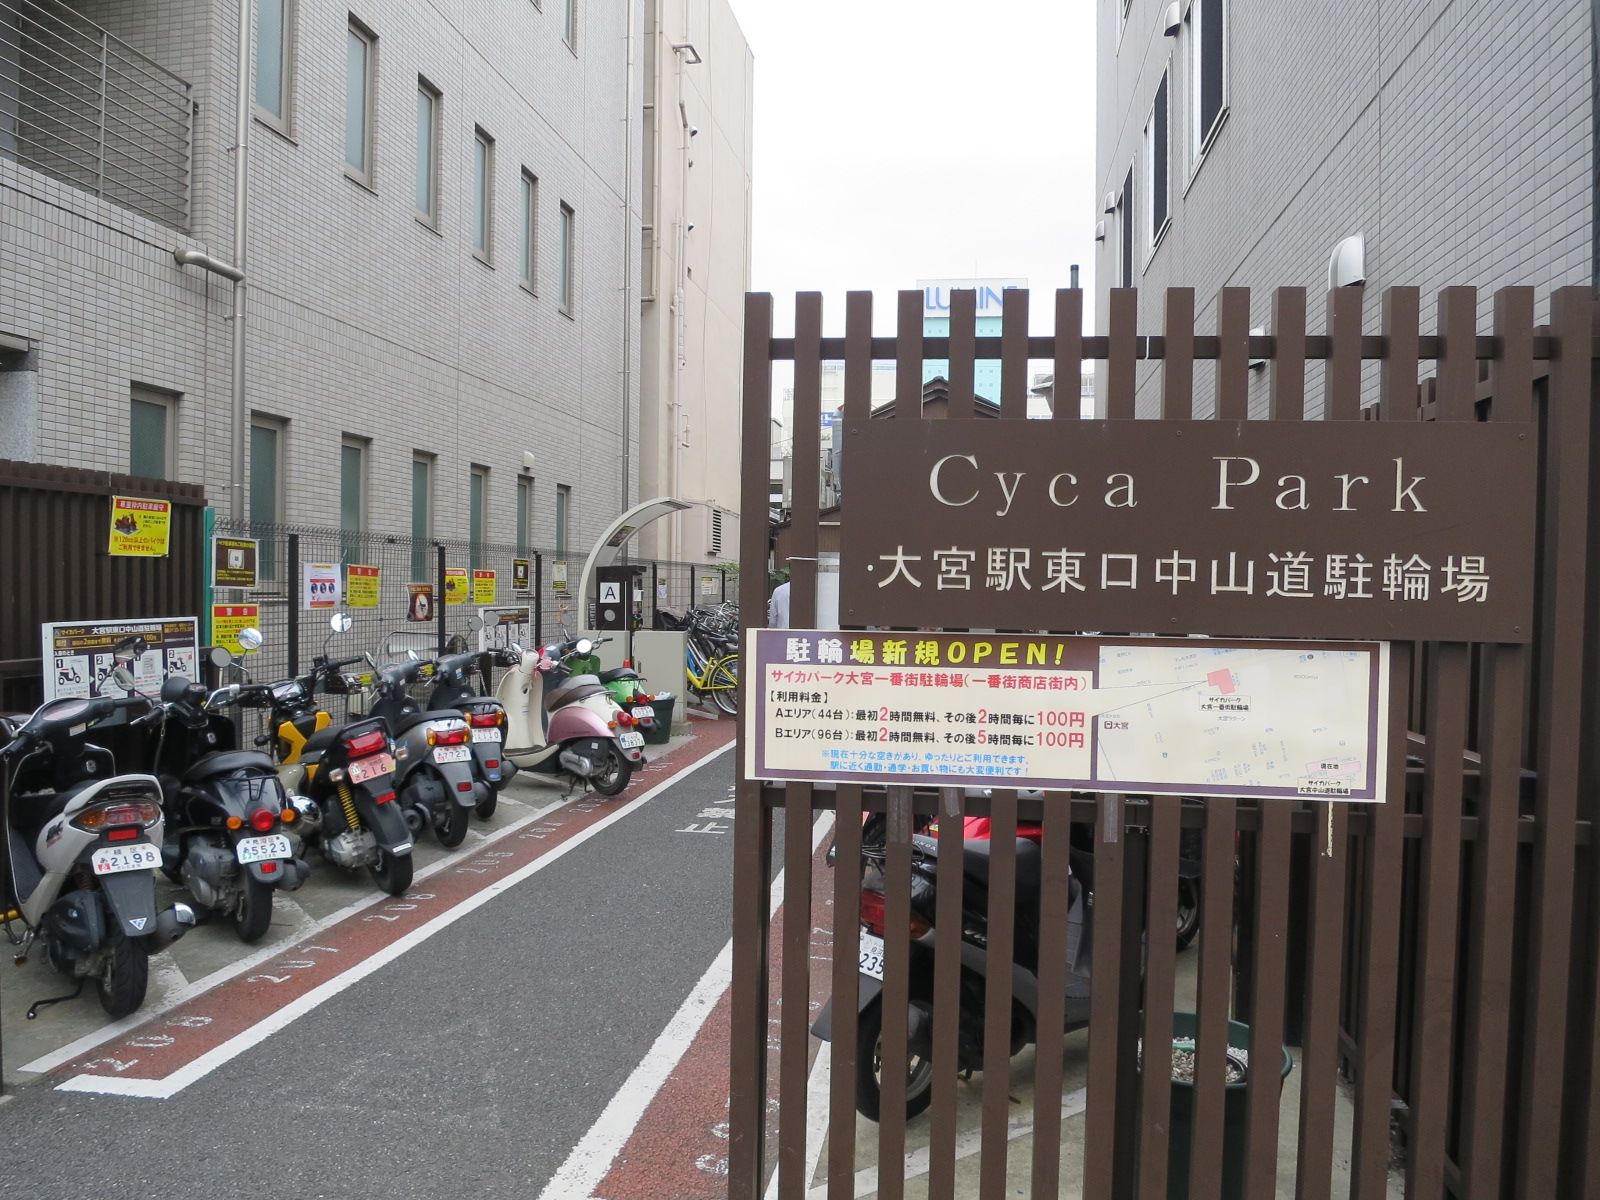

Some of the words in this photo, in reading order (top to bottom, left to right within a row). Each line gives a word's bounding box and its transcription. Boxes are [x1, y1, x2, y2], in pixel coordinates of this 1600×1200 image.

[925, 285, 1018, 310] LUIN
[929, 454, 1138, 517] Cyca
[1210, 456, 1428, 513] Park
[604, 586, 617, 600] A
[785, 637, 1065, 666] 駐輪場新規OPEN!
[770, 691, 828, 704] 【利用料金】
[1113, 721, 1129, 730] 大宮
[360, 763, 387, 779] 216
[251, 841, 286, 856] 5523
[111, 851, 155, 867] 2198
